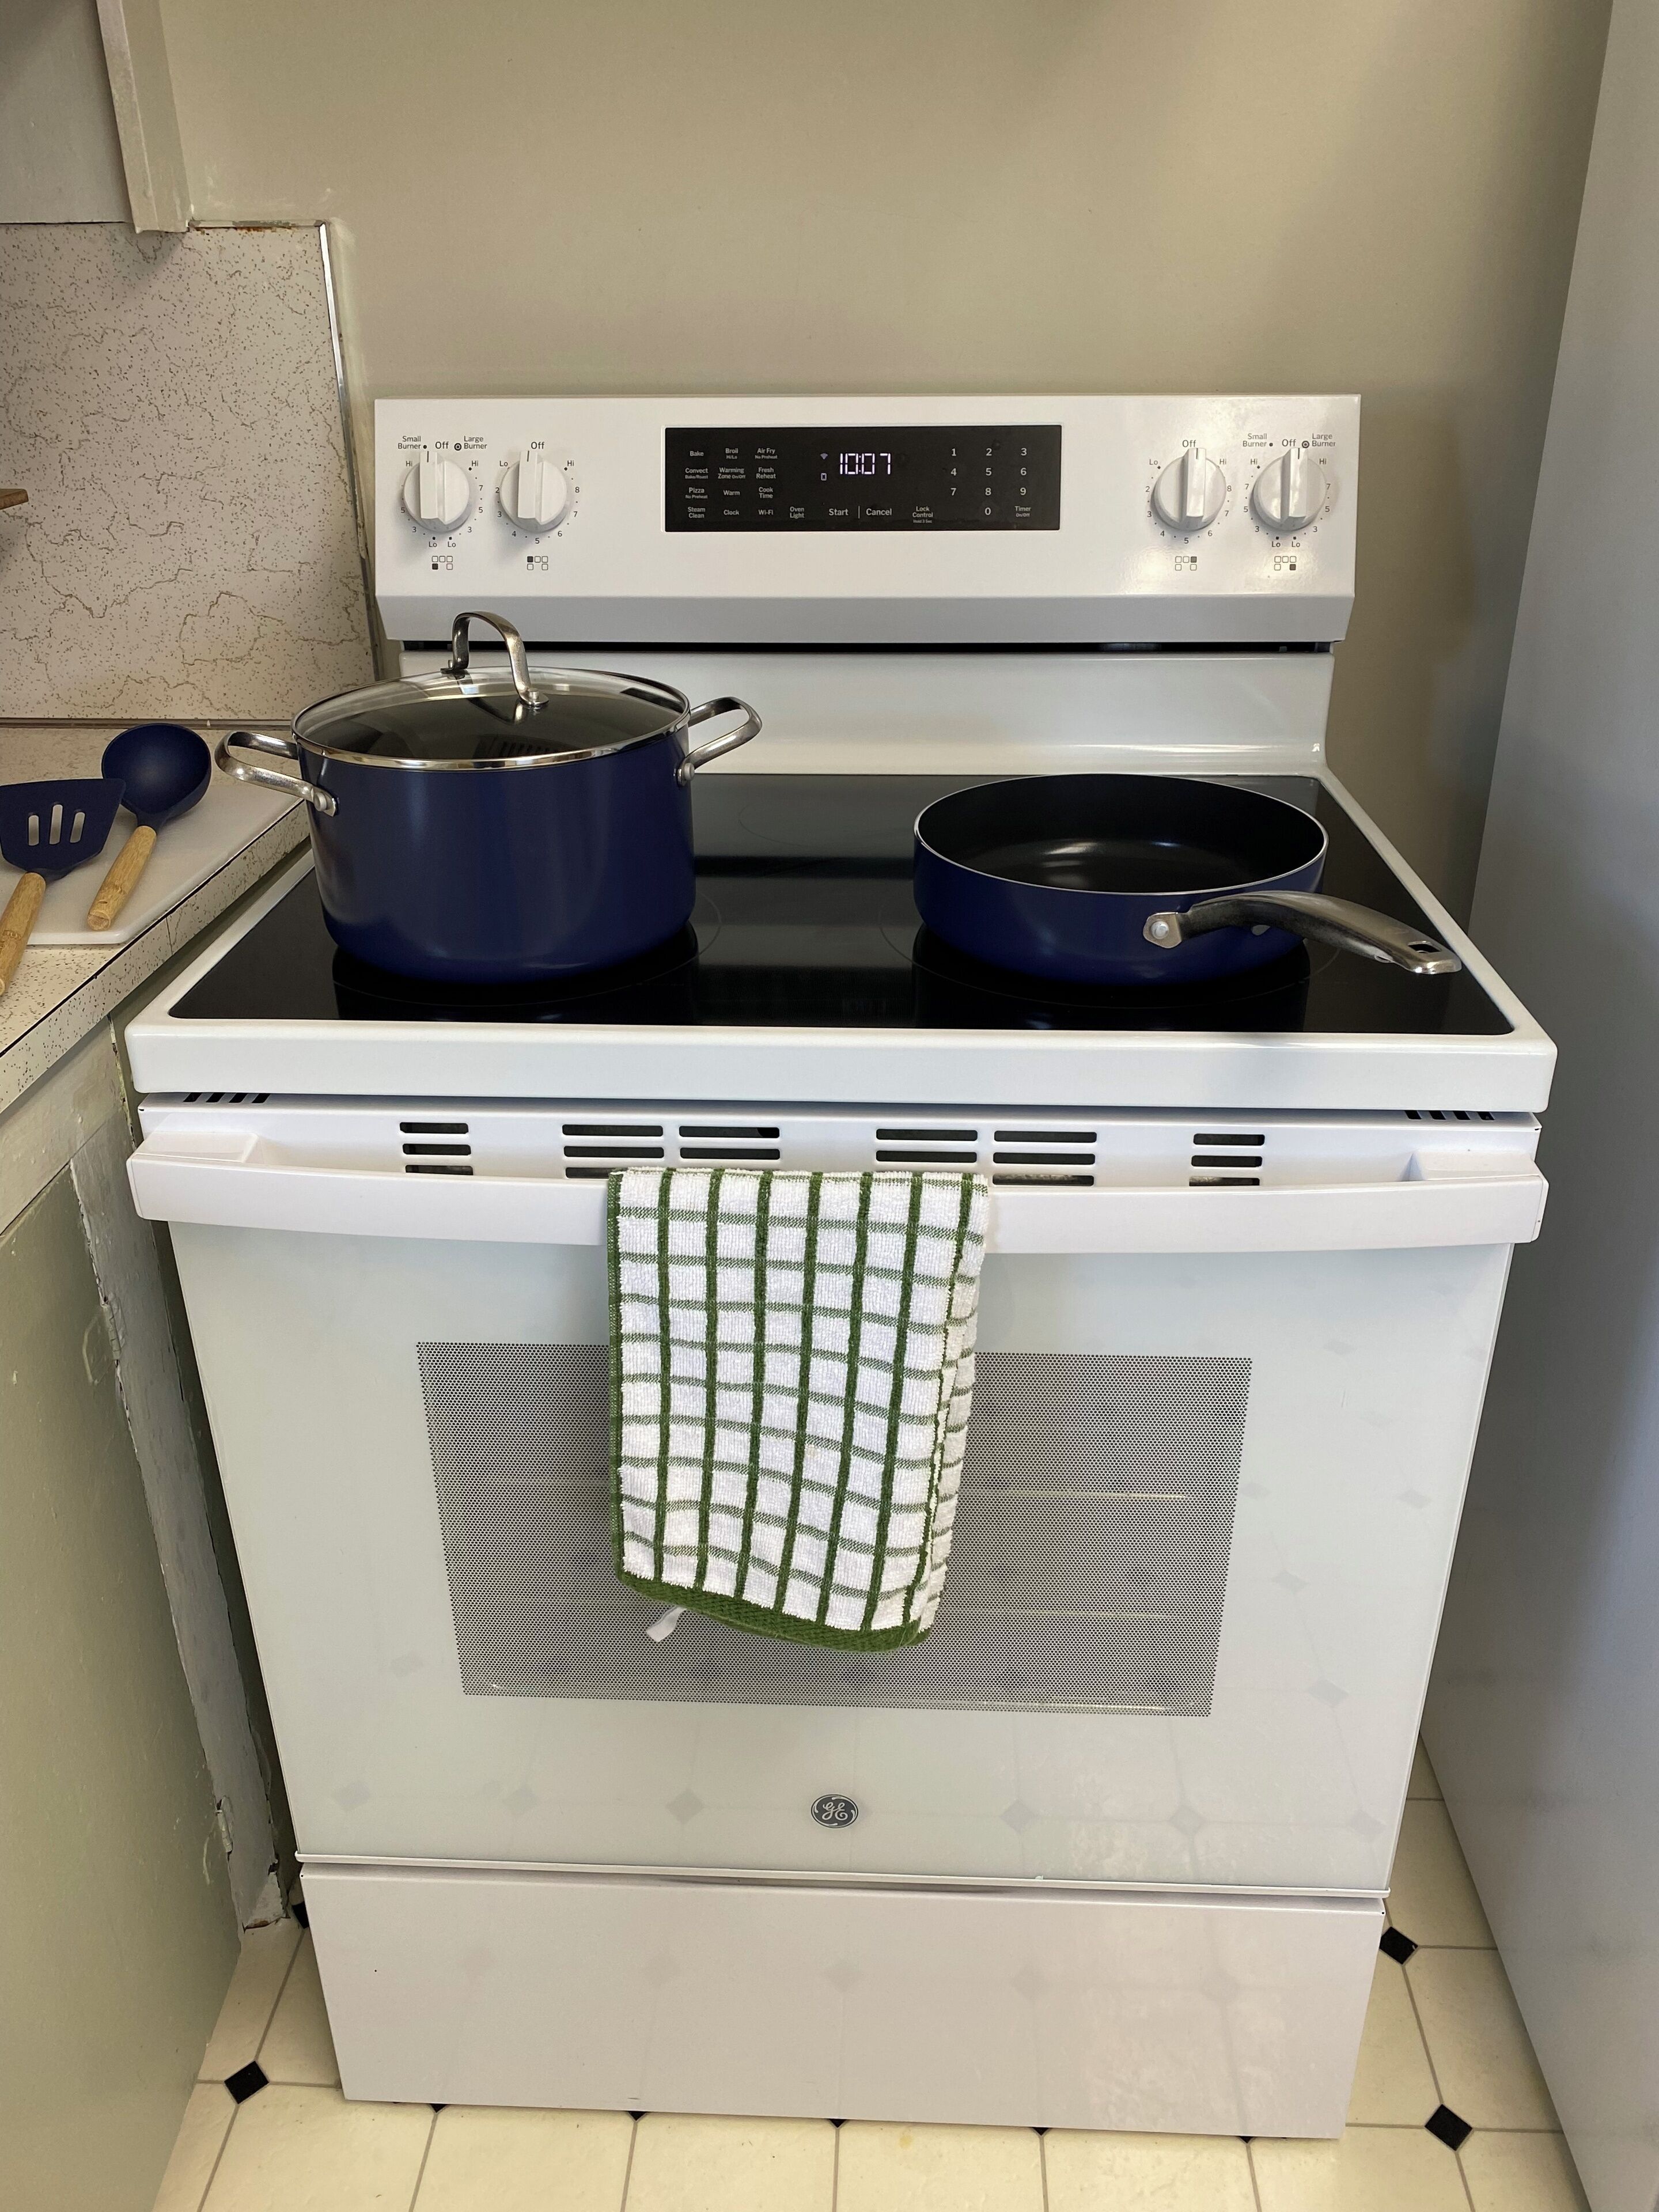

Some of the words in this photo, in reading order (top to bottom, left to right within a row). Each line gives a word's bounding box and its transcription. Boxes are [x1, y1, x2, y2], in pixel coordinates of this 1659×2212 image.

[435, 441, 449, 449] Off
[840, 453, 891, 475] 10:07
[986, 468, 991, 476] 5
[1020, 487, 1026, 495] 9
[985, 507, 991, 516] 0
